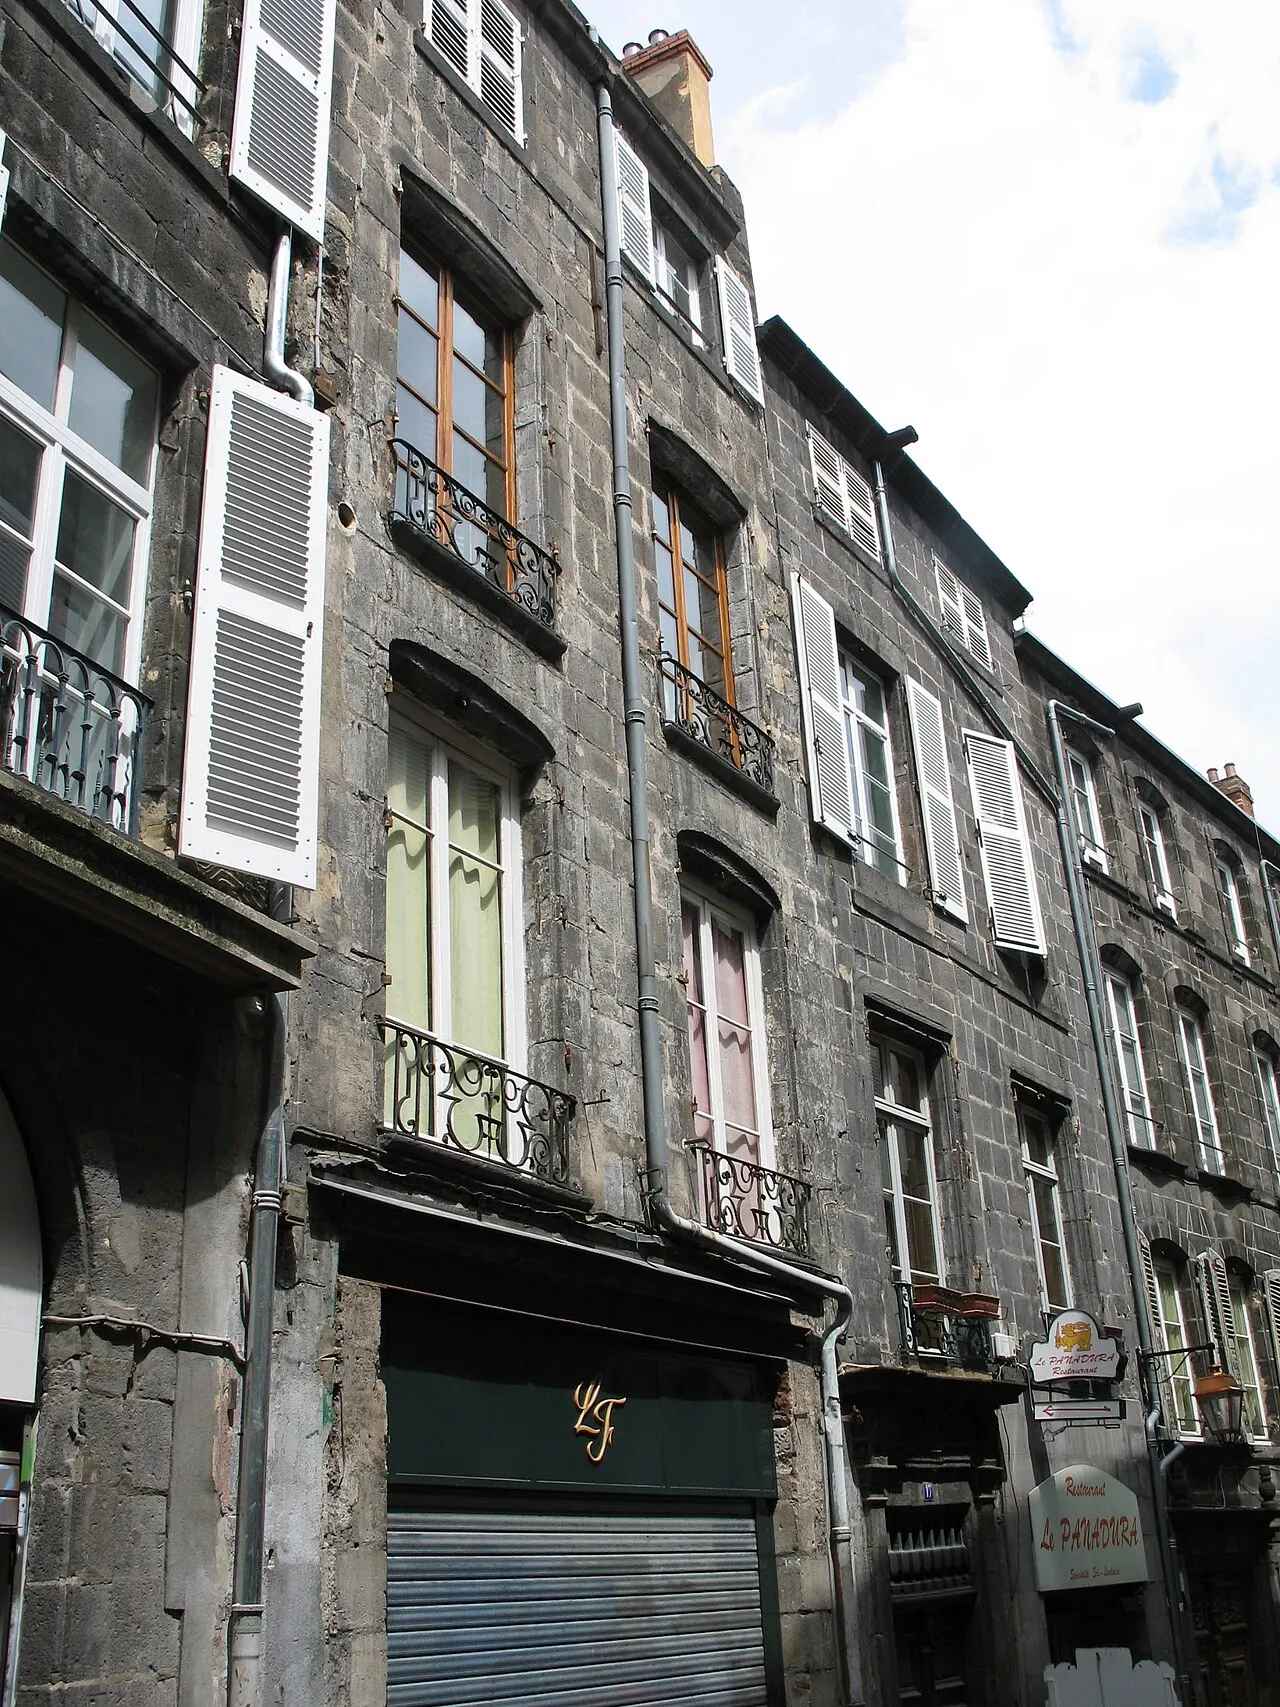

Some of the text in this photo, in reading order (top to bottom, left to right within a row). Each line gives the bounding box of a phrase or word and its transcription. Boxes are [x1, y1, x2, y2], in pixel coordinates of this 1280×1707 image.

[1034, 1353, 1115, 1366] Le PANADURA
[1052, 1366, 1098, 1376] Restaurant
[1064, 1476, 1106, 1497] Restaurant
[1040, 1515, 1139, 1552] Le PANADURA
